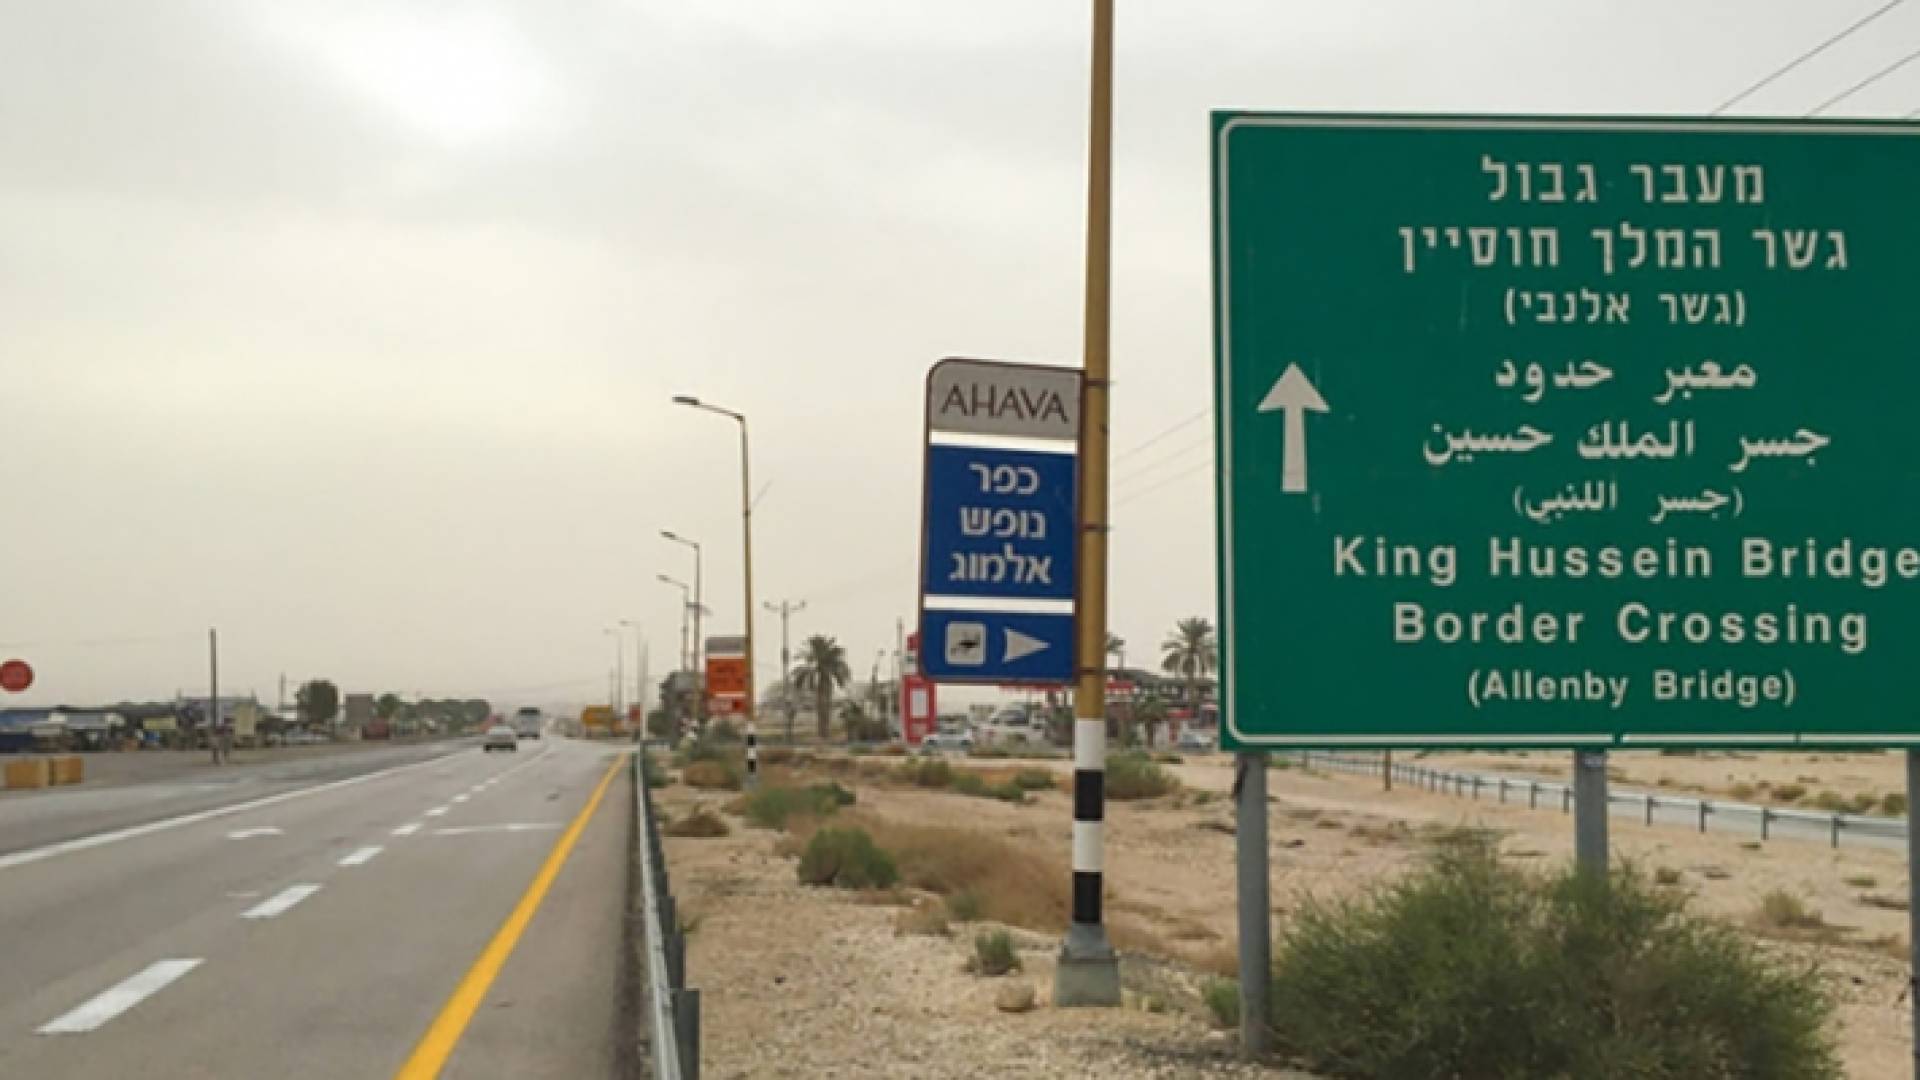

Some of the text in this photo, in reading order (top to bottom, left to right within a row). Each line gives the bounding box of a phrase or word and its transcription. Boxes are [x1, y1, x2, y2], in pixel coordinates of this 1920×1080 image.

[1482, 155, 1764, 203] מעבר גבול
[1398, 222, 1848, 274] גשר המלך חוסיין
[939, 381, 1070, 425] AHAVA
[1495, 361, 1756, 404] معبر حدود
[1423, 420, 1829, 473] جسر الملك حسين
[970, 463, 1038, 495] כפר
[960, 507, 1046, 538] נופש
[950, 543, 1051, 584] אלמוג
[1334, 536, 1920, 587] King Hussein Bridge
[1395, 602, 1867, 654] Border Crossing
[1468, 669, 1794, 708] (Allenby Bridge)
